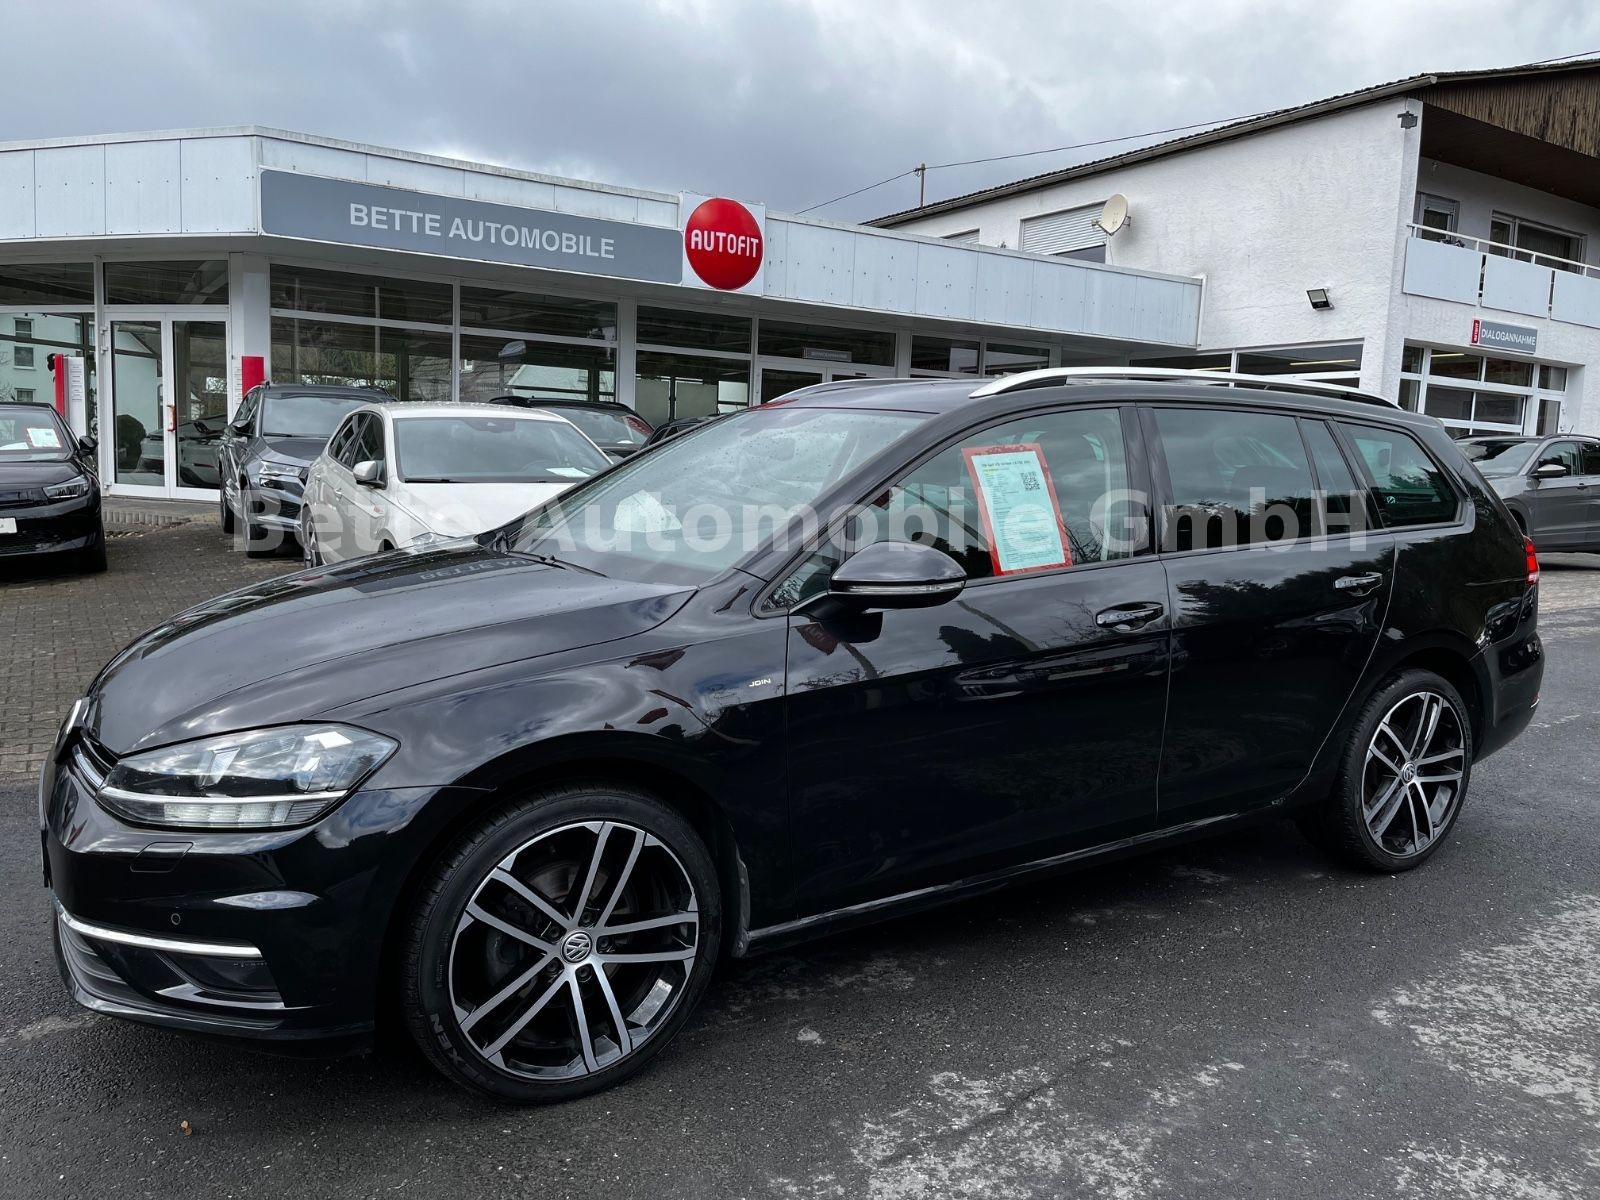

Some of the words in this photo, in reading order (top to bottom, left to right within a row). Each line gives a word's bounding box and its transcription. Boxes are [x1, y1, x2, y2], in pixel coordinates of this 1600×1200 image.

[350, 203, 441, 236] BETTE
[449, 217, 615, 259] AUTOMOBILE
[691, 229, 759, 258] AUTOFIT
[1481, 328, 1536, 346] DIALOGANNAHME
[749, 678, 771, 687] JOIN
